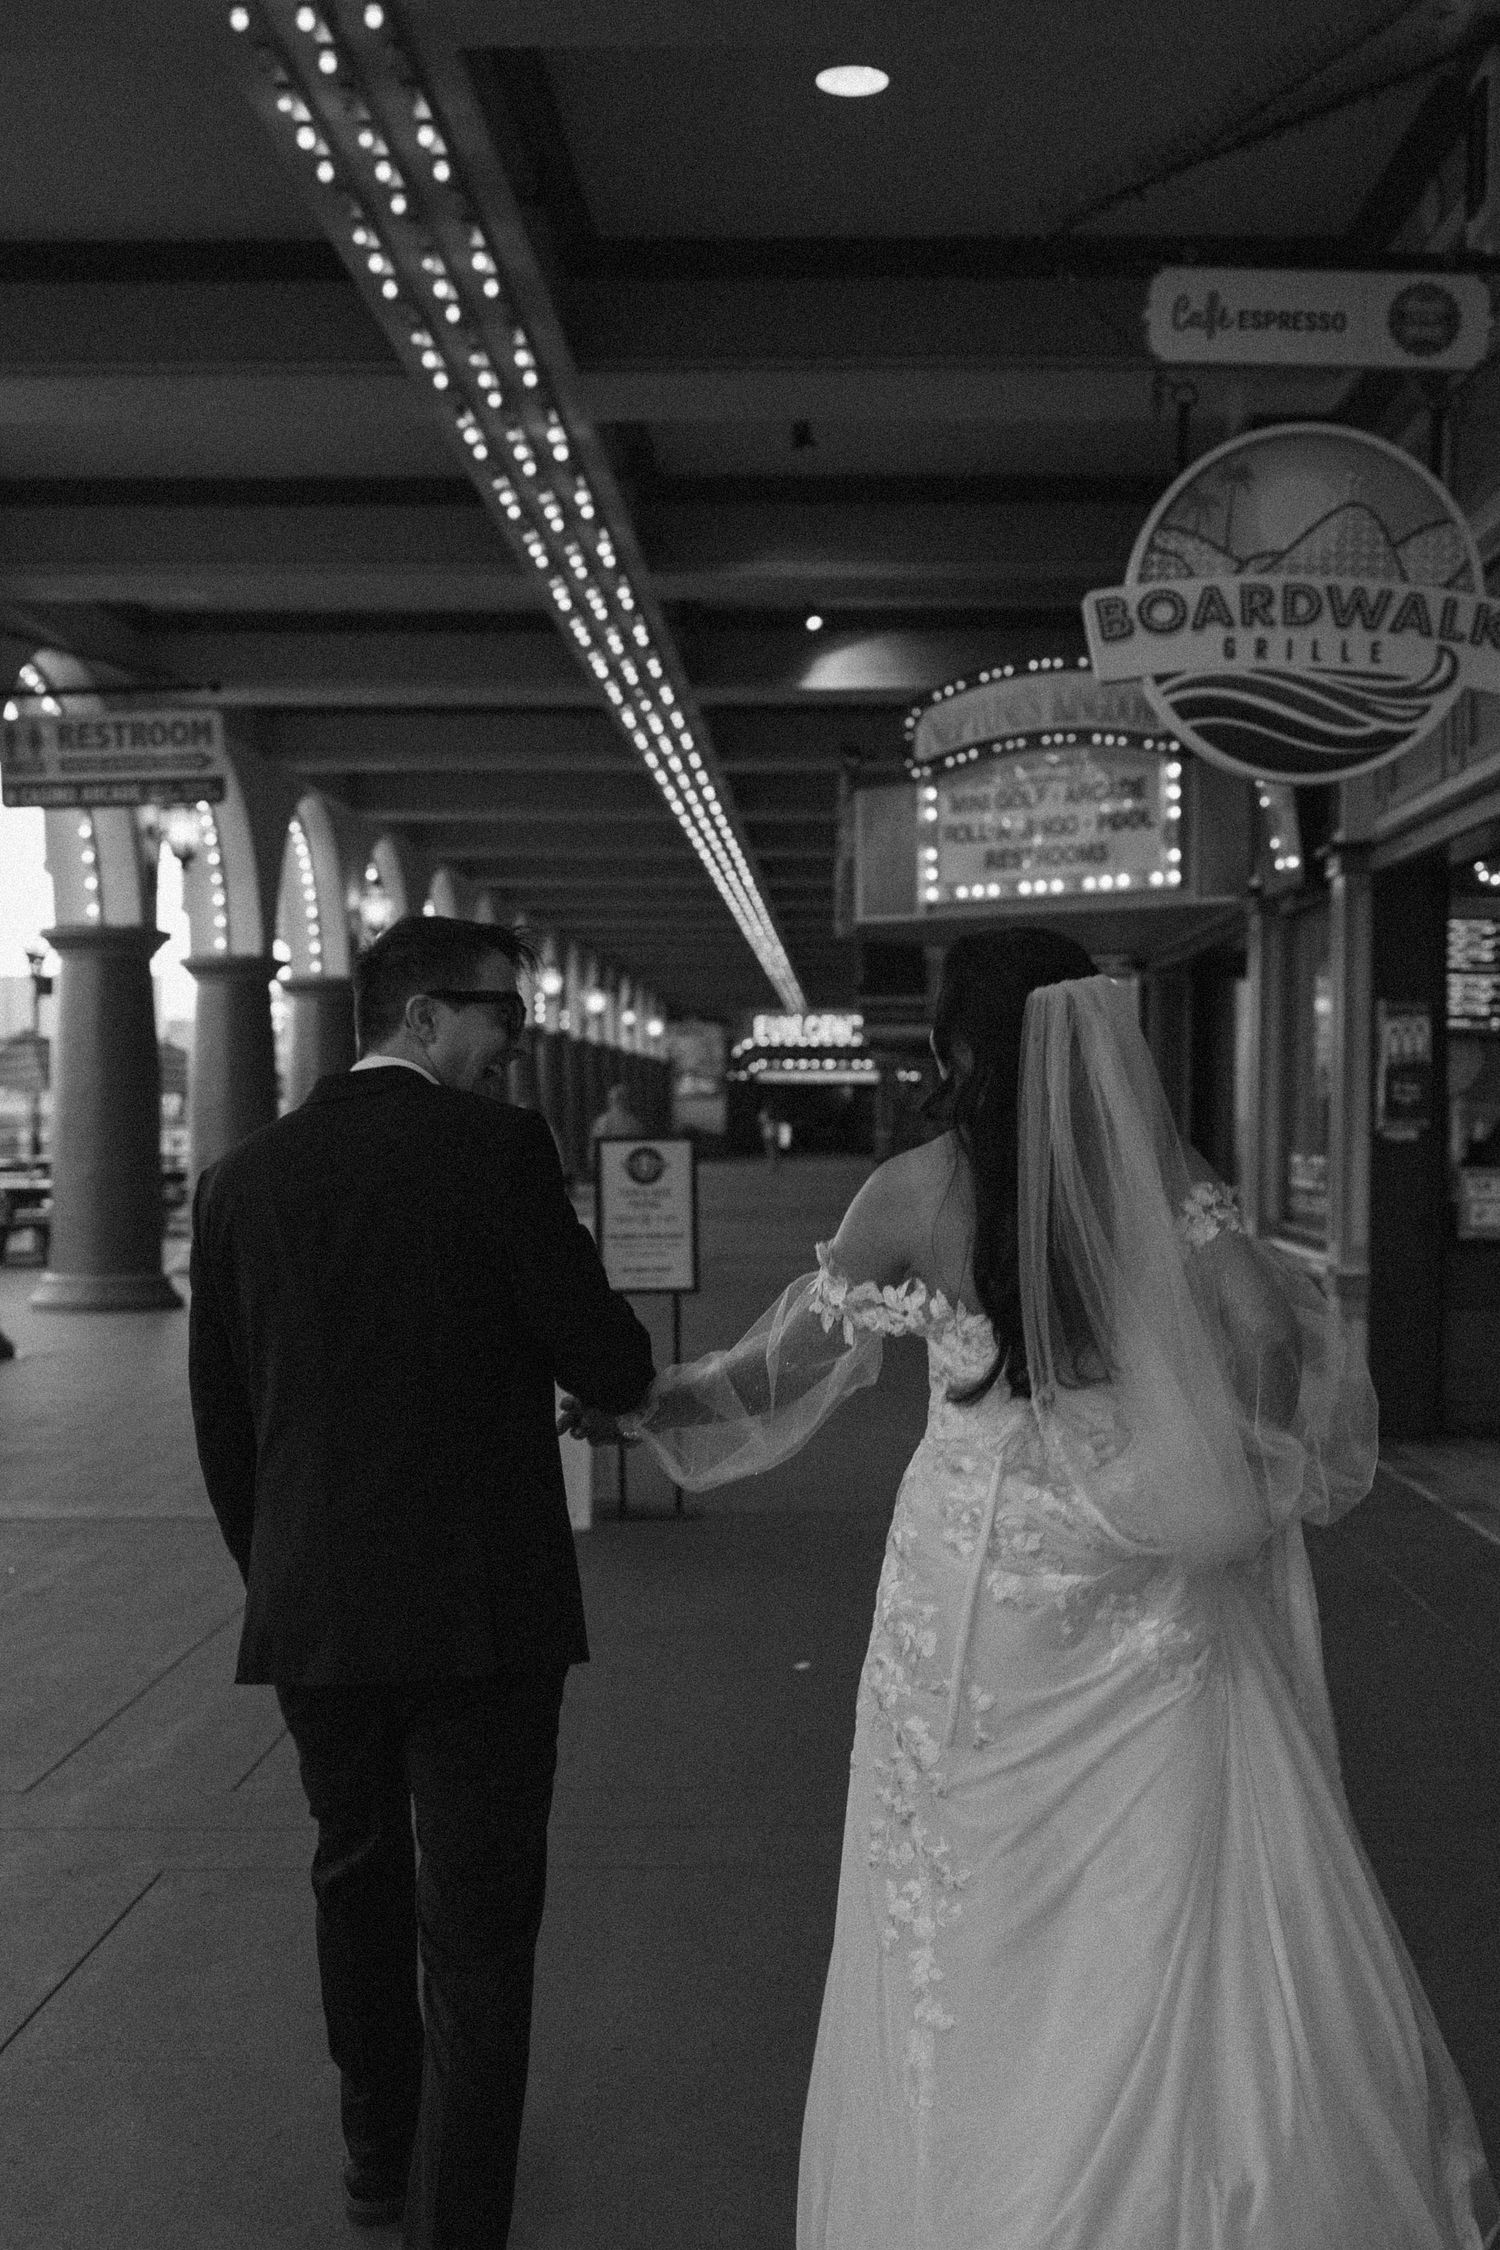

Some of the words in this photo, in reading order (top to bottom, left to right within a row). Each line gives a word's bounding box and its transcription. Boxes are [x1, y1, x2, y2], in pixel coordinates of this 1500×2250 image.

[1238, 309, 1348, 333] ESPRESSO
[1094, 582, 1500, 650] BOARDWALK
[1223, 636, 1382, 664] GRILLE
[57, 721, 213, 749] RESTROOM
